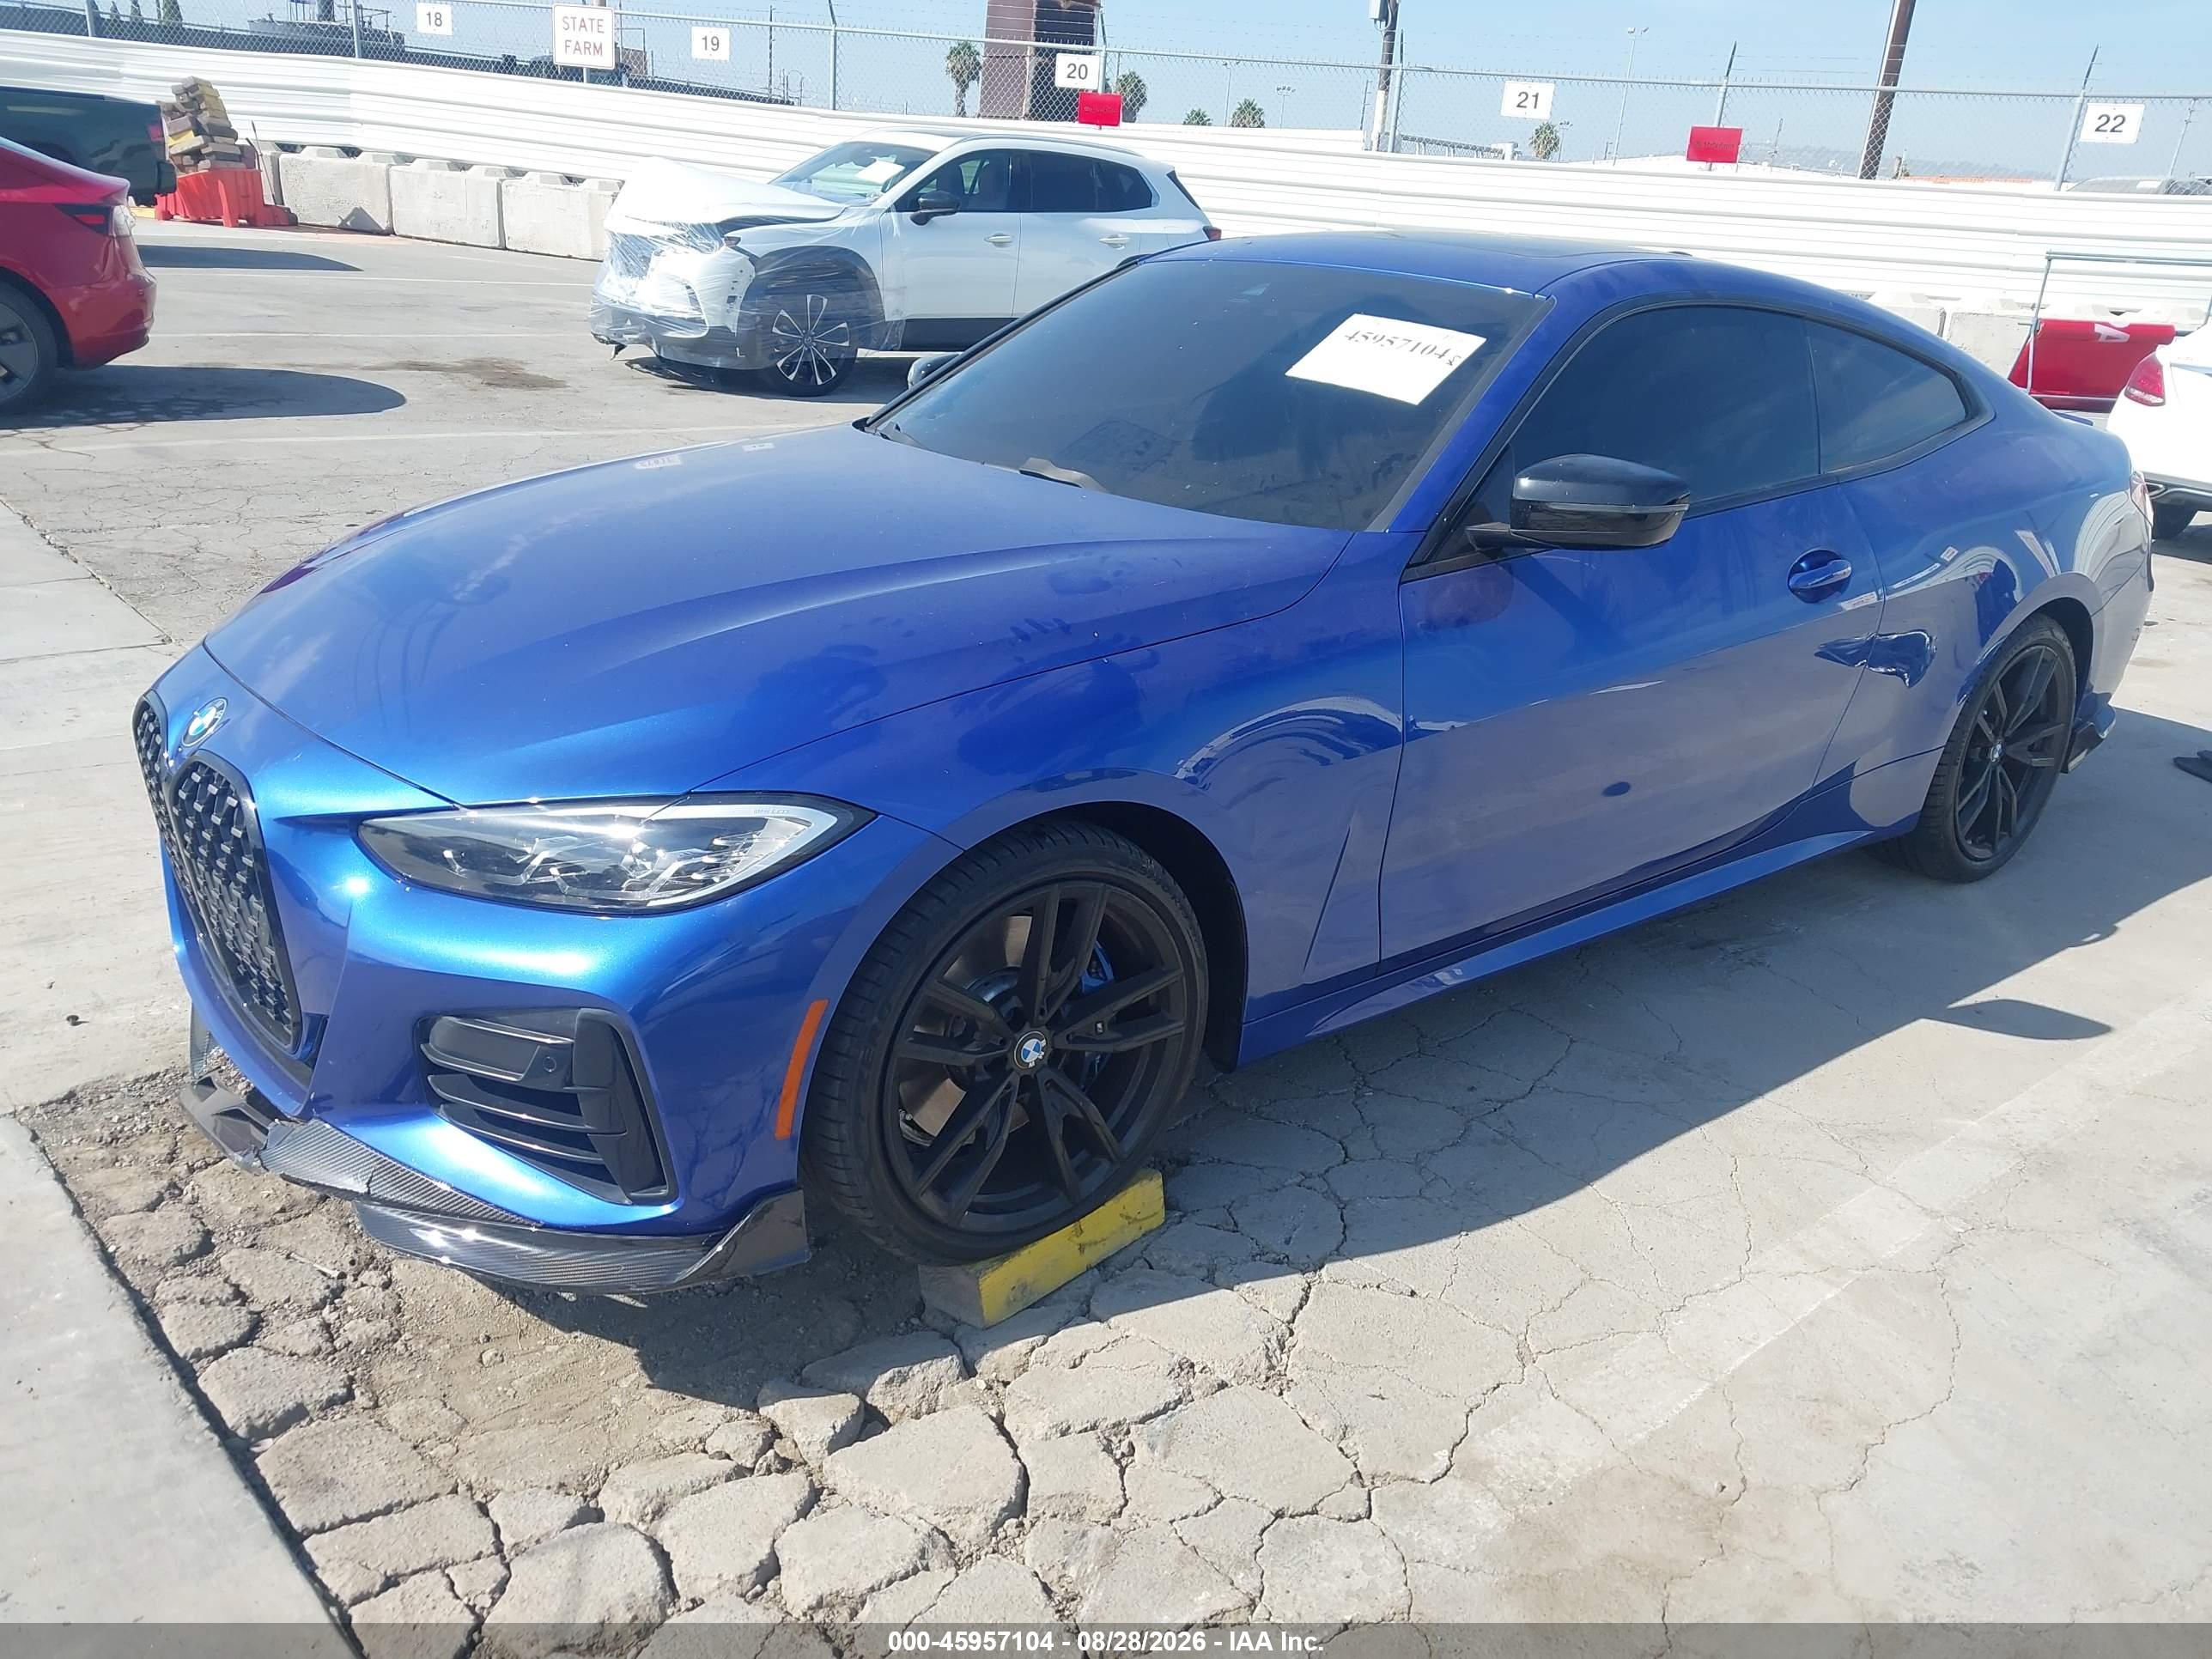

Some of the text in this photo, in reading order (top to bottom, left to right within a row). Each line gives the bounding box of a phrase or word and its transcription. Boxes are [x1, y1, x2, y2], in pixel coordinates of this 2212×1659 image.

[426, 11, 443, 27] 18
[562, 15, 605, 33] STATE
[564, 40, 604, 57] FARM
[702, 35, 720, 52] 19
[1066, 63, 1089, 80] 20
[1516, 91, 1540, 109] 21
[2094, 113, 2126, 133] 22
